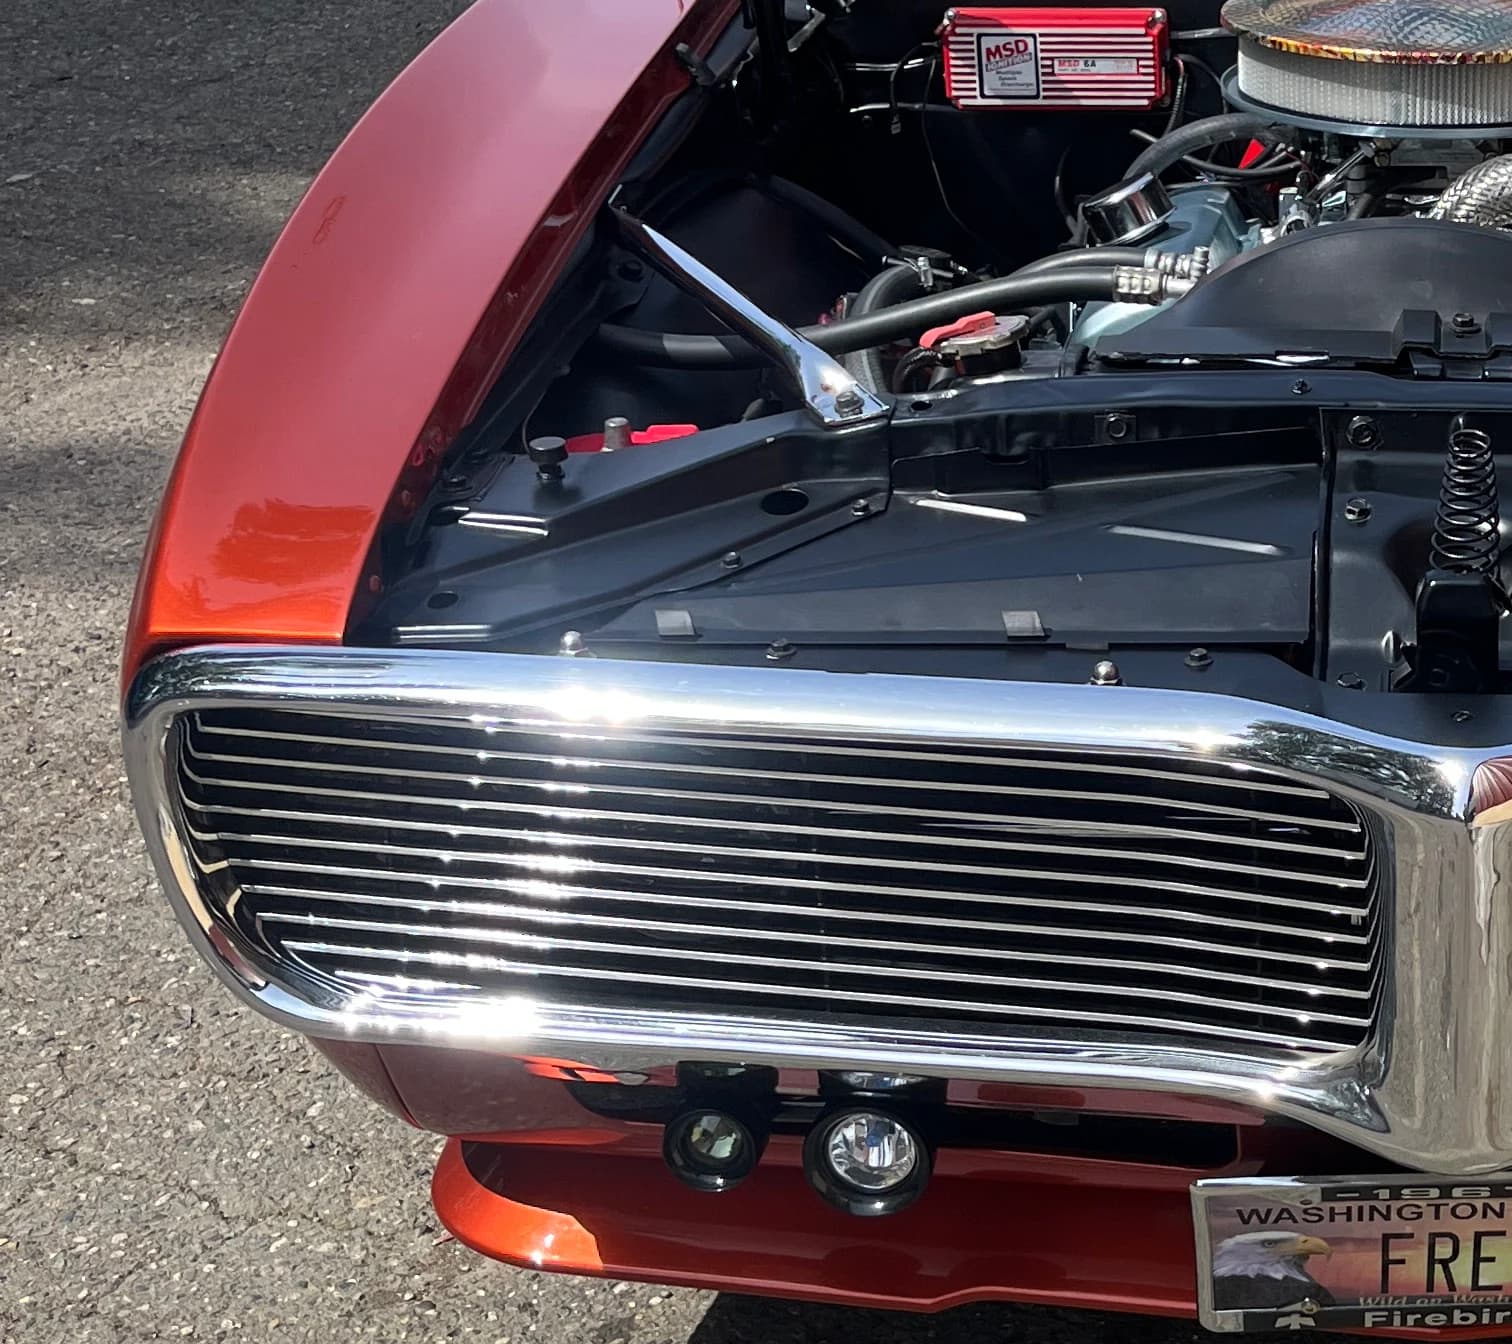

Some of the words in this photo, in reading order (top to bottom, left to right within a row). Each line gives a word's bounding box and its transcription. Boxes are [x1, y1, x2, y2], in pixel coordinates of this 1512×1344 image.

[985, 39, 1029, 63] MSD
[1236, 1202, 1506, 1225] WASHINGTON
[1359, 1293, 1408, 1307] Wild
[1415, 1296, 1443, 1306] on
